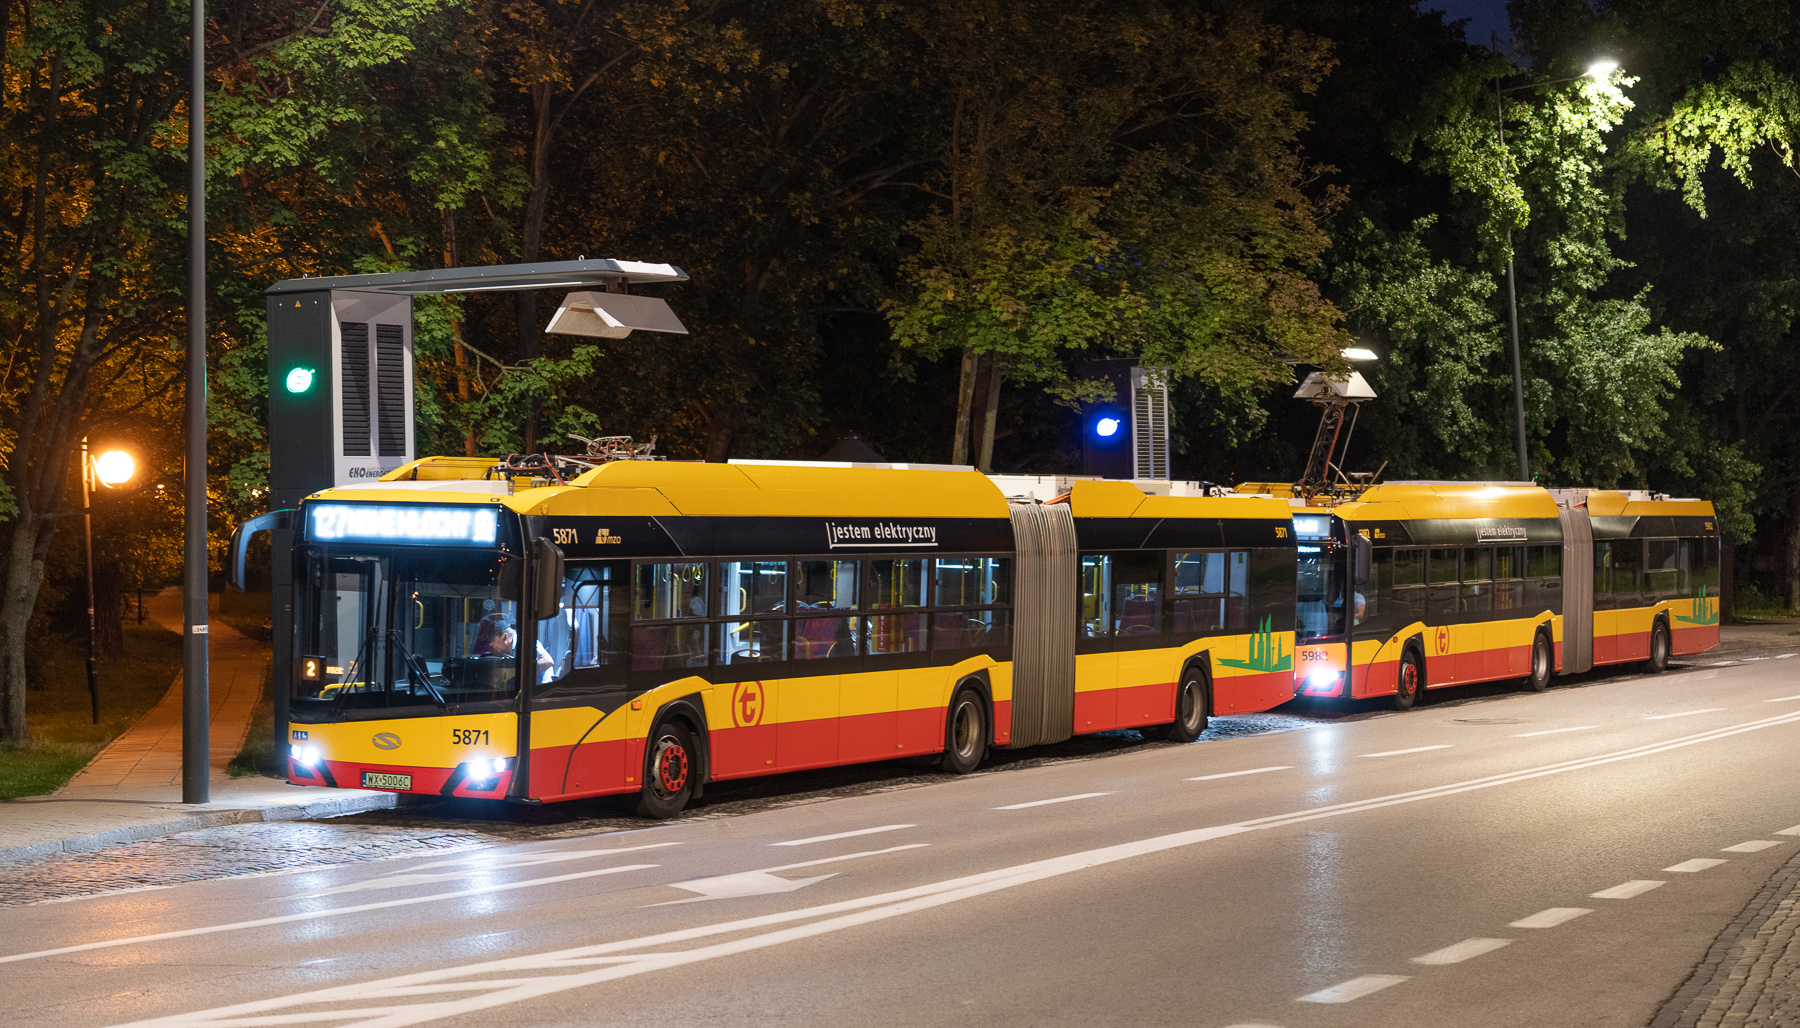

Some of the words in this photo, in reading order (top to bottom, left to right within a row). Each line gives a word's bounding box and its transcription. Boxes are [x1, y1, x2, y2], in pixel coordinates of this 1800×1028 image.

[314, 507, 348, 537] 127
[553, 528, 578, 544] 5871
[832, 522, 871, 542] jestem
[875, 522, 936, 542] elektryczny
[1275, 527, 1288, 538] 5871
[1478, 525, 1496, 538] jestem
[1497, 524, 1526, 537] elektryczny
[1302, 651, 1328, 661] 5982
[307, 660, 316, 677] 2
[453, 729, 489, 746] 5871
[367, 773, 380, 785] WX
[382, 775, 409, 787] 5006C
